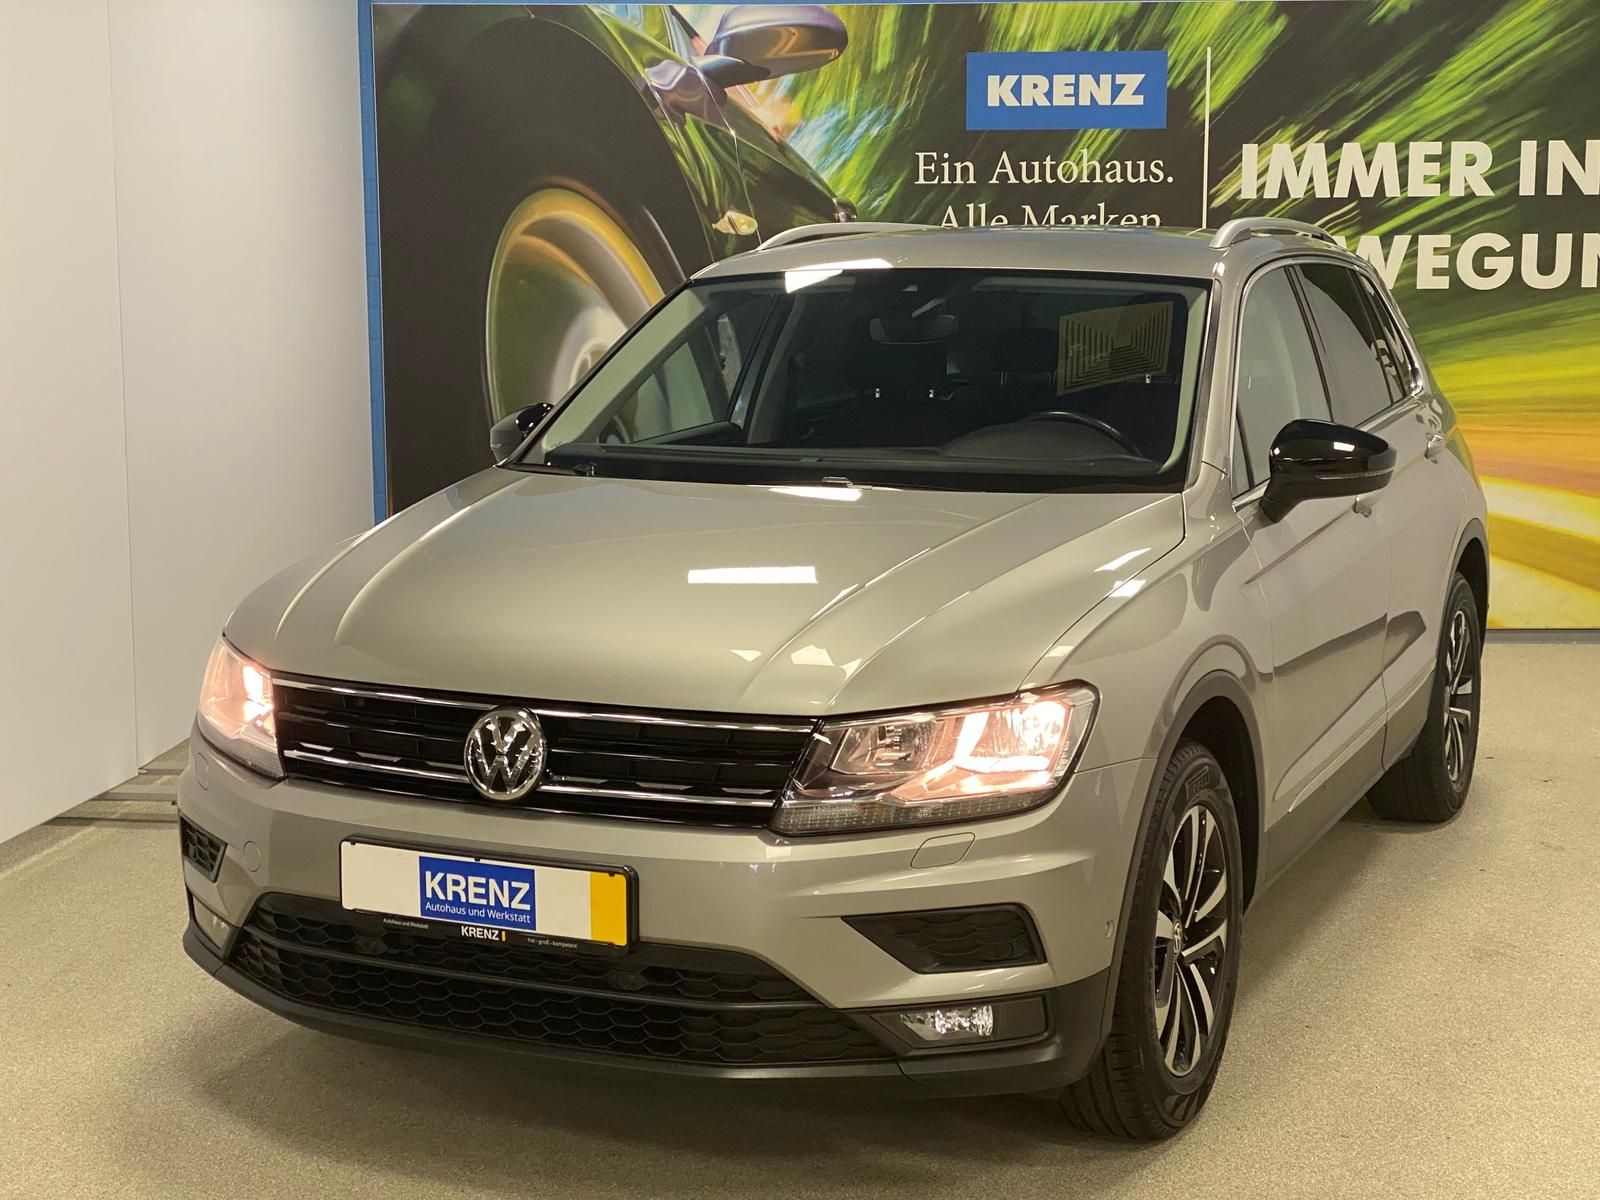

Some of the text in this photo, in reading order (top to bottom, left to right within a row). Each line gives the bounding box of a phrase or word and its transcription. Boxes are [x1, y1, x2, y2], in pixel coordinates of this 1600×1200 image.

[987, 73, 1146, 107] KRENZ
[914, 148, 1174, 184] Ein Autohaus.
[1240, 139, 1600, 199] IMMER IN
[425, 870, 531, 911] KRENZ
[425, 901, 531, 924] Autohaus und Werkstatt
[460, 925, 501, 941] KRENZ
